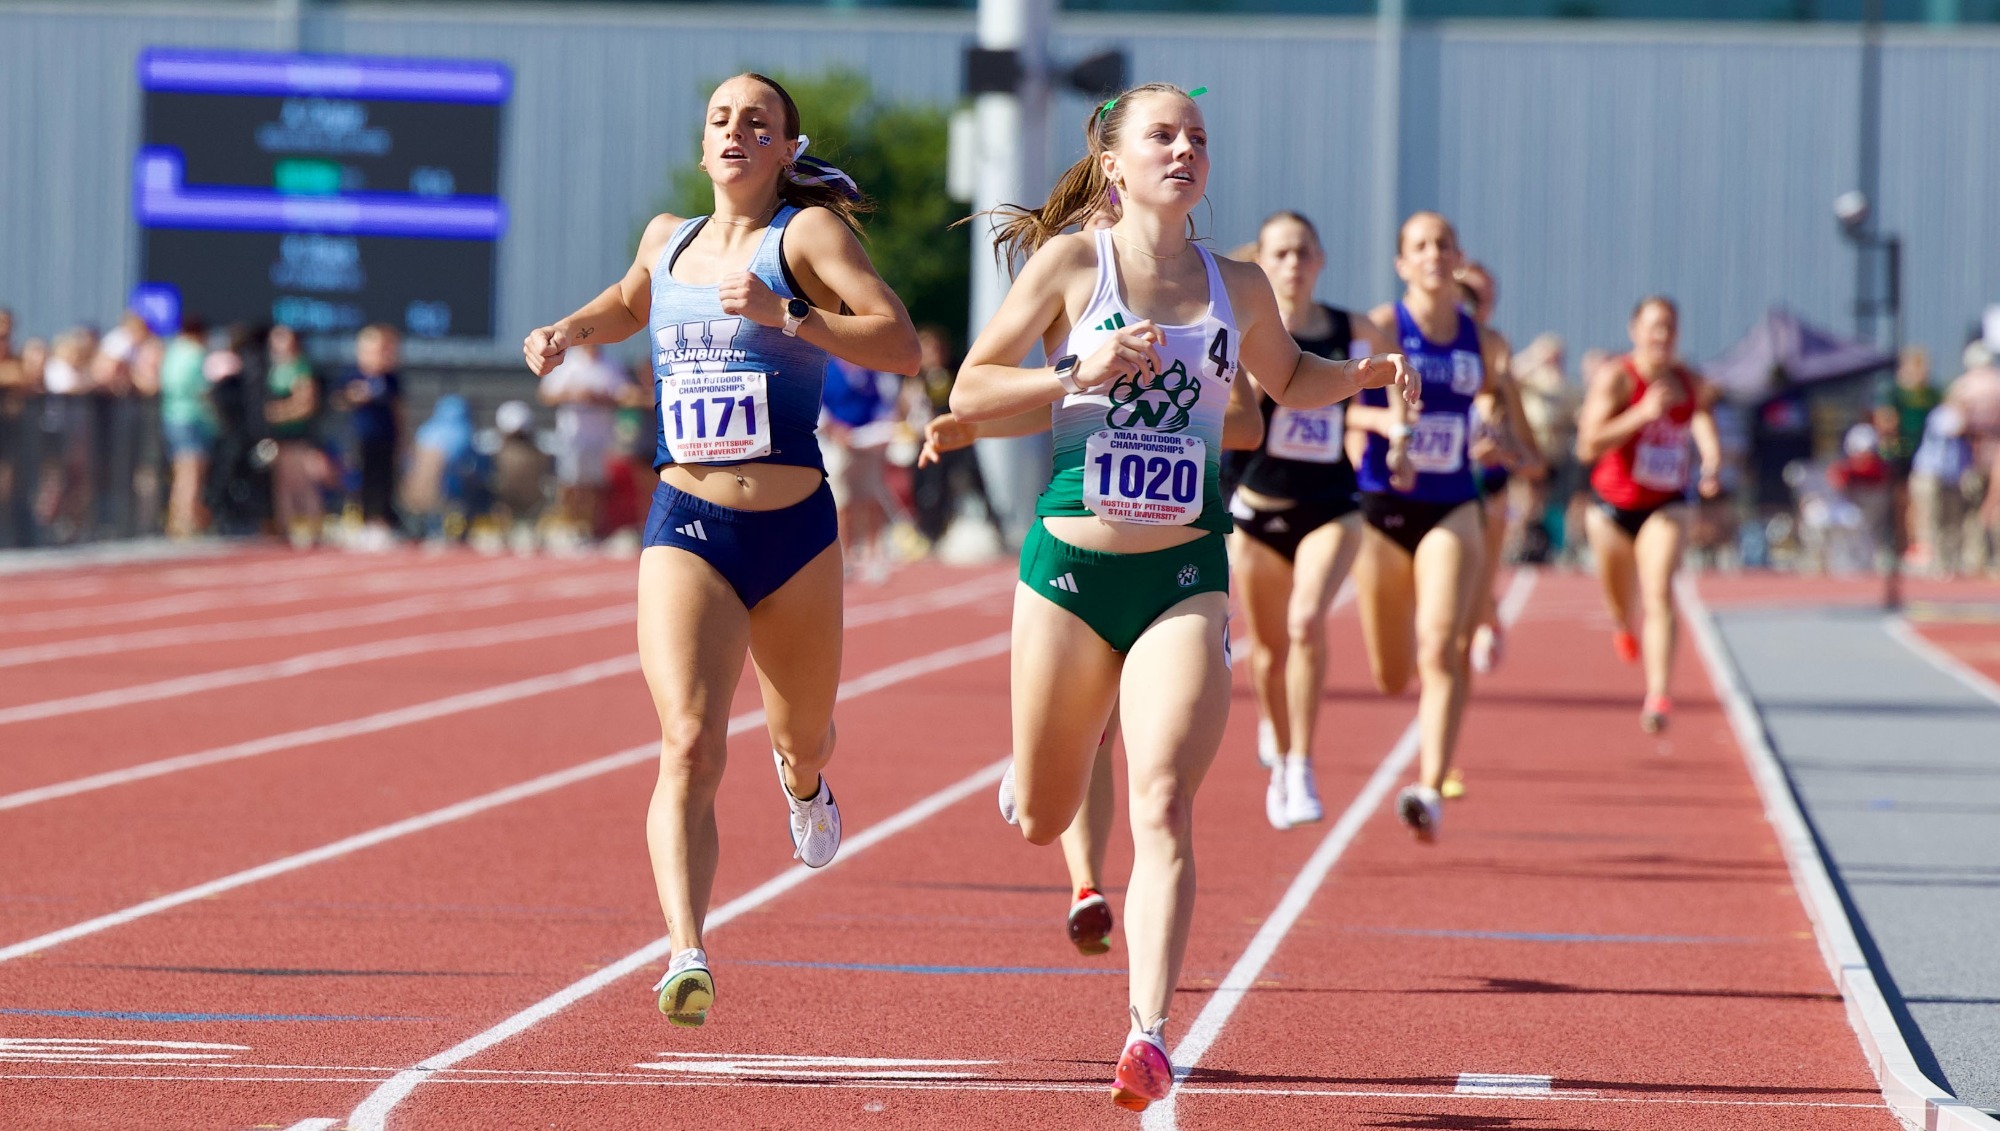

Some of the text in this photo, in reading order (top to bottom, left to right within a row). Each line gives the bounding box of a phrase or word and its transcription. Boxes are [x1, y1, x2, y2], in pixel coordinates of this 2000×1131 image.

[657, 348, 747, 367] WASHBURN
[1208, 327, 1229, 378] 4
[681, 375, 743, 386] MIAA OUTDOOR
[678, 384, 746, 395] CHAMPIONSHIPS
[669, 395, 757, 440] 1171
[677, 439, 754, 450] HOSTED BY PITTSBURG
[1114, 431, 1182, 445] MIAA OUTDOOR
[683, 447, 747, 457] STATE UNIVERSITY
[1110, 440, 1185, 455] CHAMPIONSHIPS
[1094, 453, 1198, 504] 1020
[1101, 499, 1186, 514] HOSTED BY PITTSBURG
[1108, 508, 1178, 520] STATE UNIVERSITY
